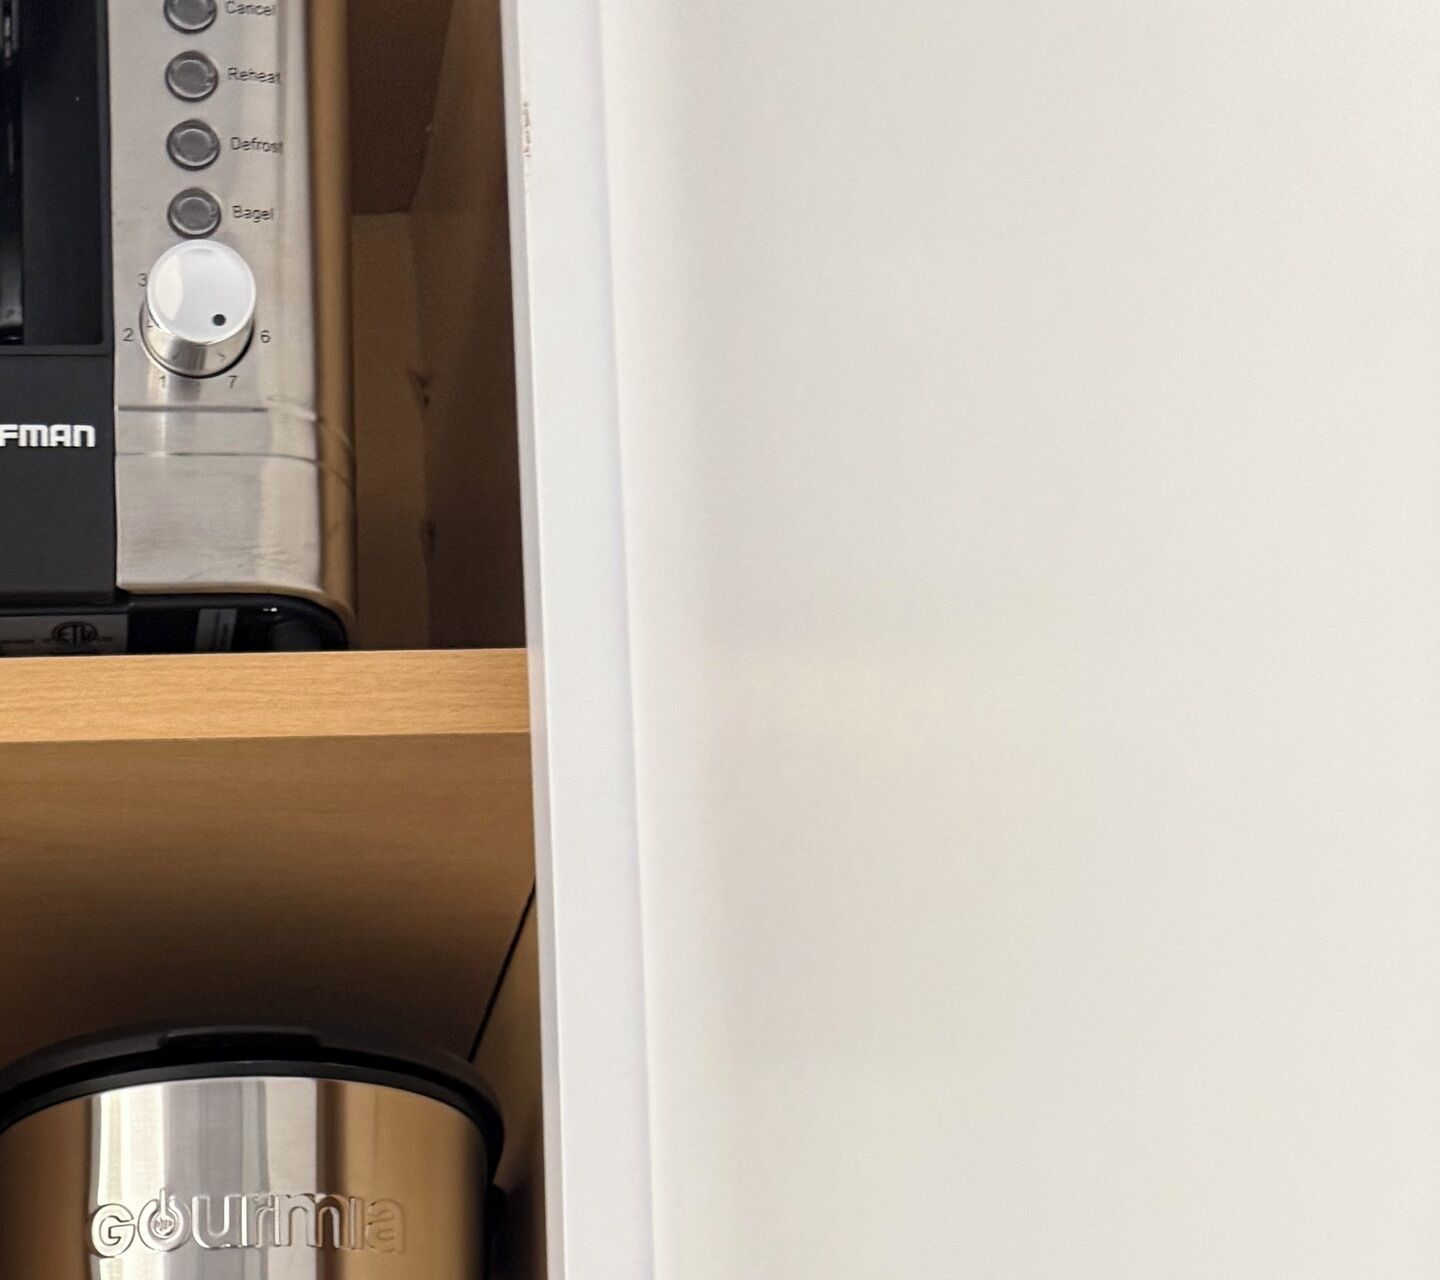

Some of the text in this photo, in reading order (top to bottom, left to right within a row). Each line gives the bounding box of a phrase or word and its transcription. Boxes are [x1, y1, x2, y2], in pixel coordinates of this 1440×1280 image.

[225, 0, 276, 16] Cancel
[228, 66, 280, 84] Reheat
[231, 136, 284, 153] Defrost
[232, 204, 274, 223] Bagel
[137, 273, 148, 287] 3
[122, 327, 135, 342] 2
[260, 329, 271, 343] 6
[228, 375, 238, 388] 7
[91, 1189, 407, 1258] Gourmia
